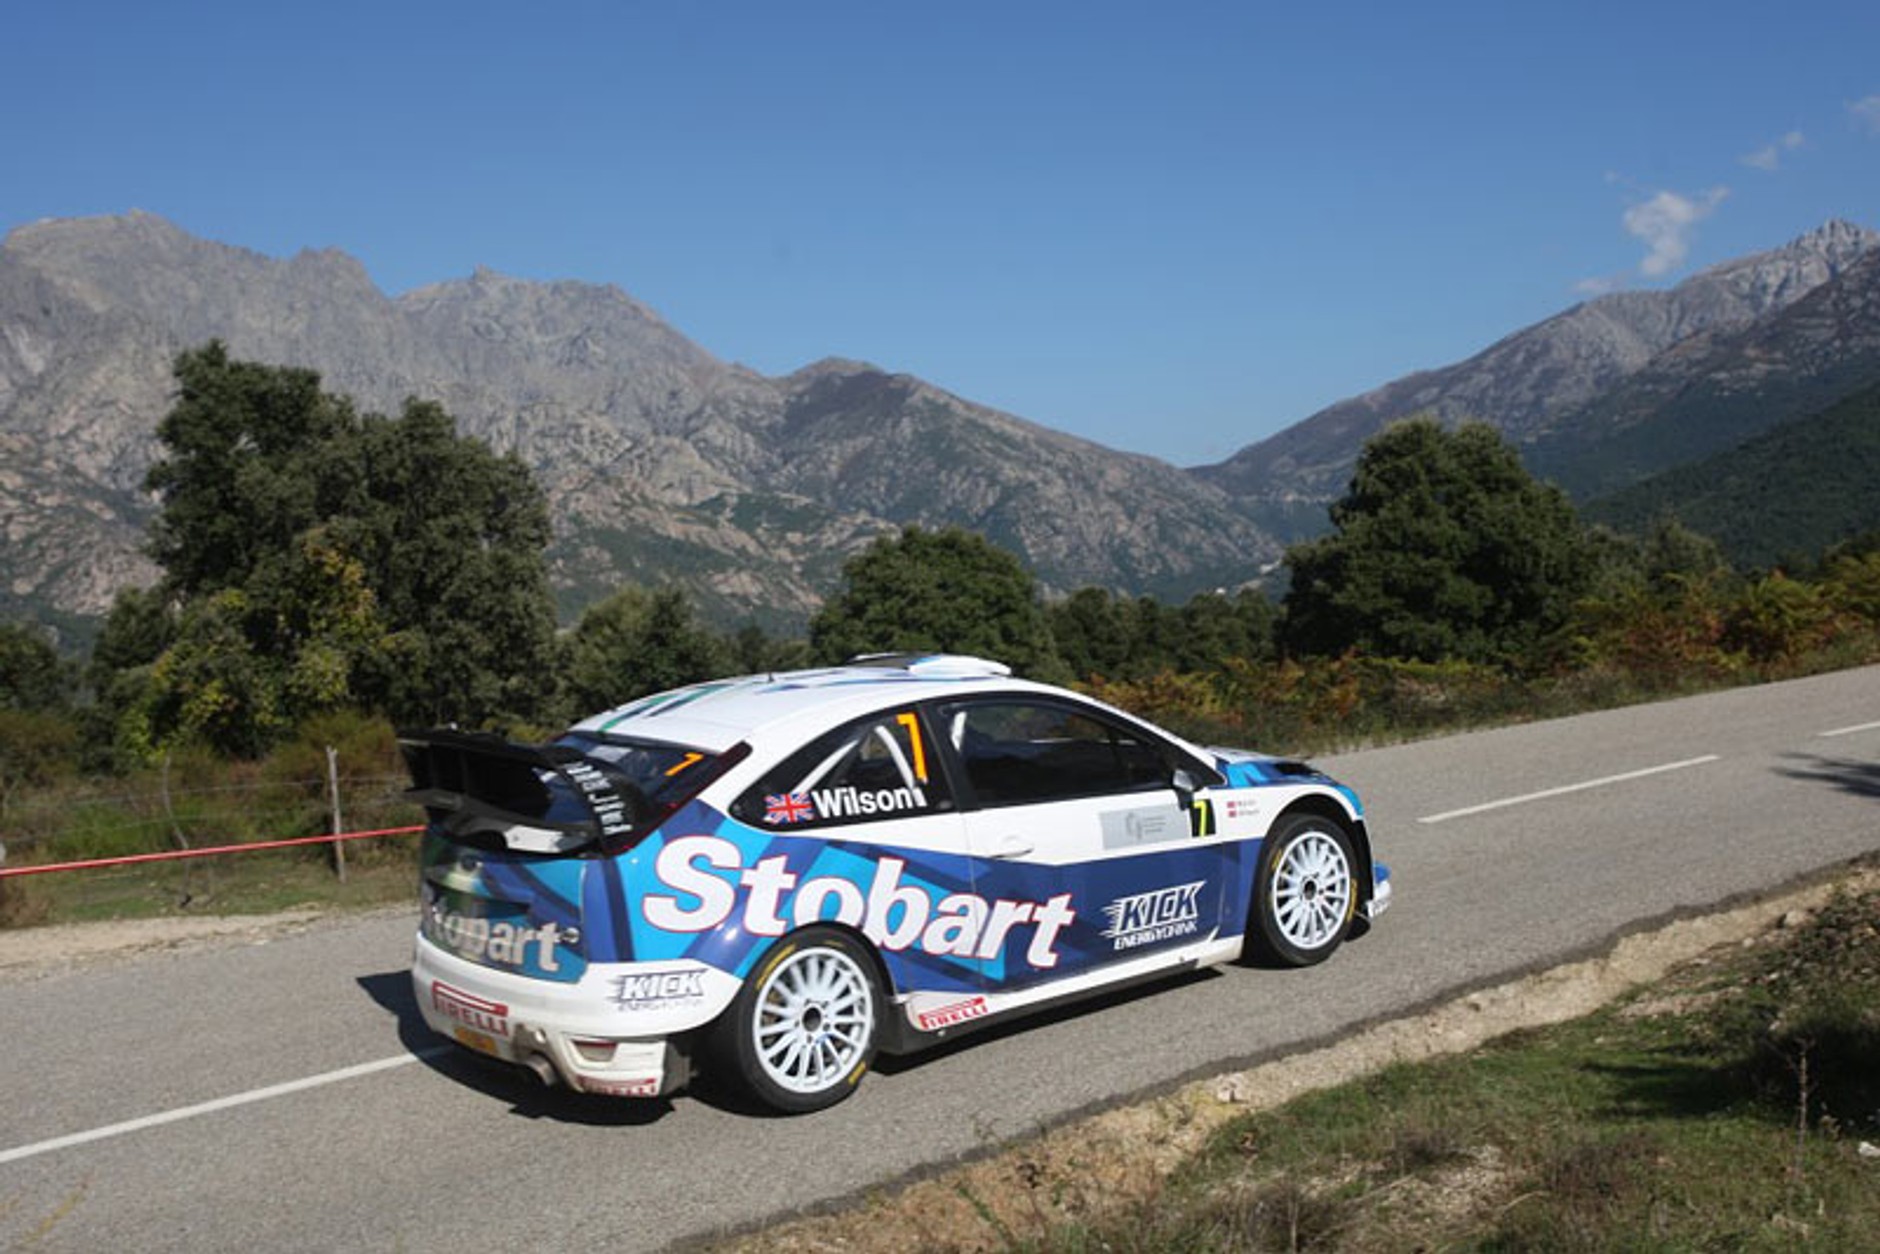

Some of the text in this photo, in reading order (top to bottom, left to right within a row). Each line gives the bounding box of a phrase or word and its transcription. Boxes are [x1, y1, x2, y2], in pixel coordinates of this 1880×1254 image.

[811, 786, 914, 819] Wilson
[643, 835, 1076, 968] Stobart
[1115, 882, 1202, 934] KICK
[616, 970, 705, 1001] KICK
[432, 980, 509, 1037] PIRELLI
[919, 996, 988, 1029] PIRELLI
